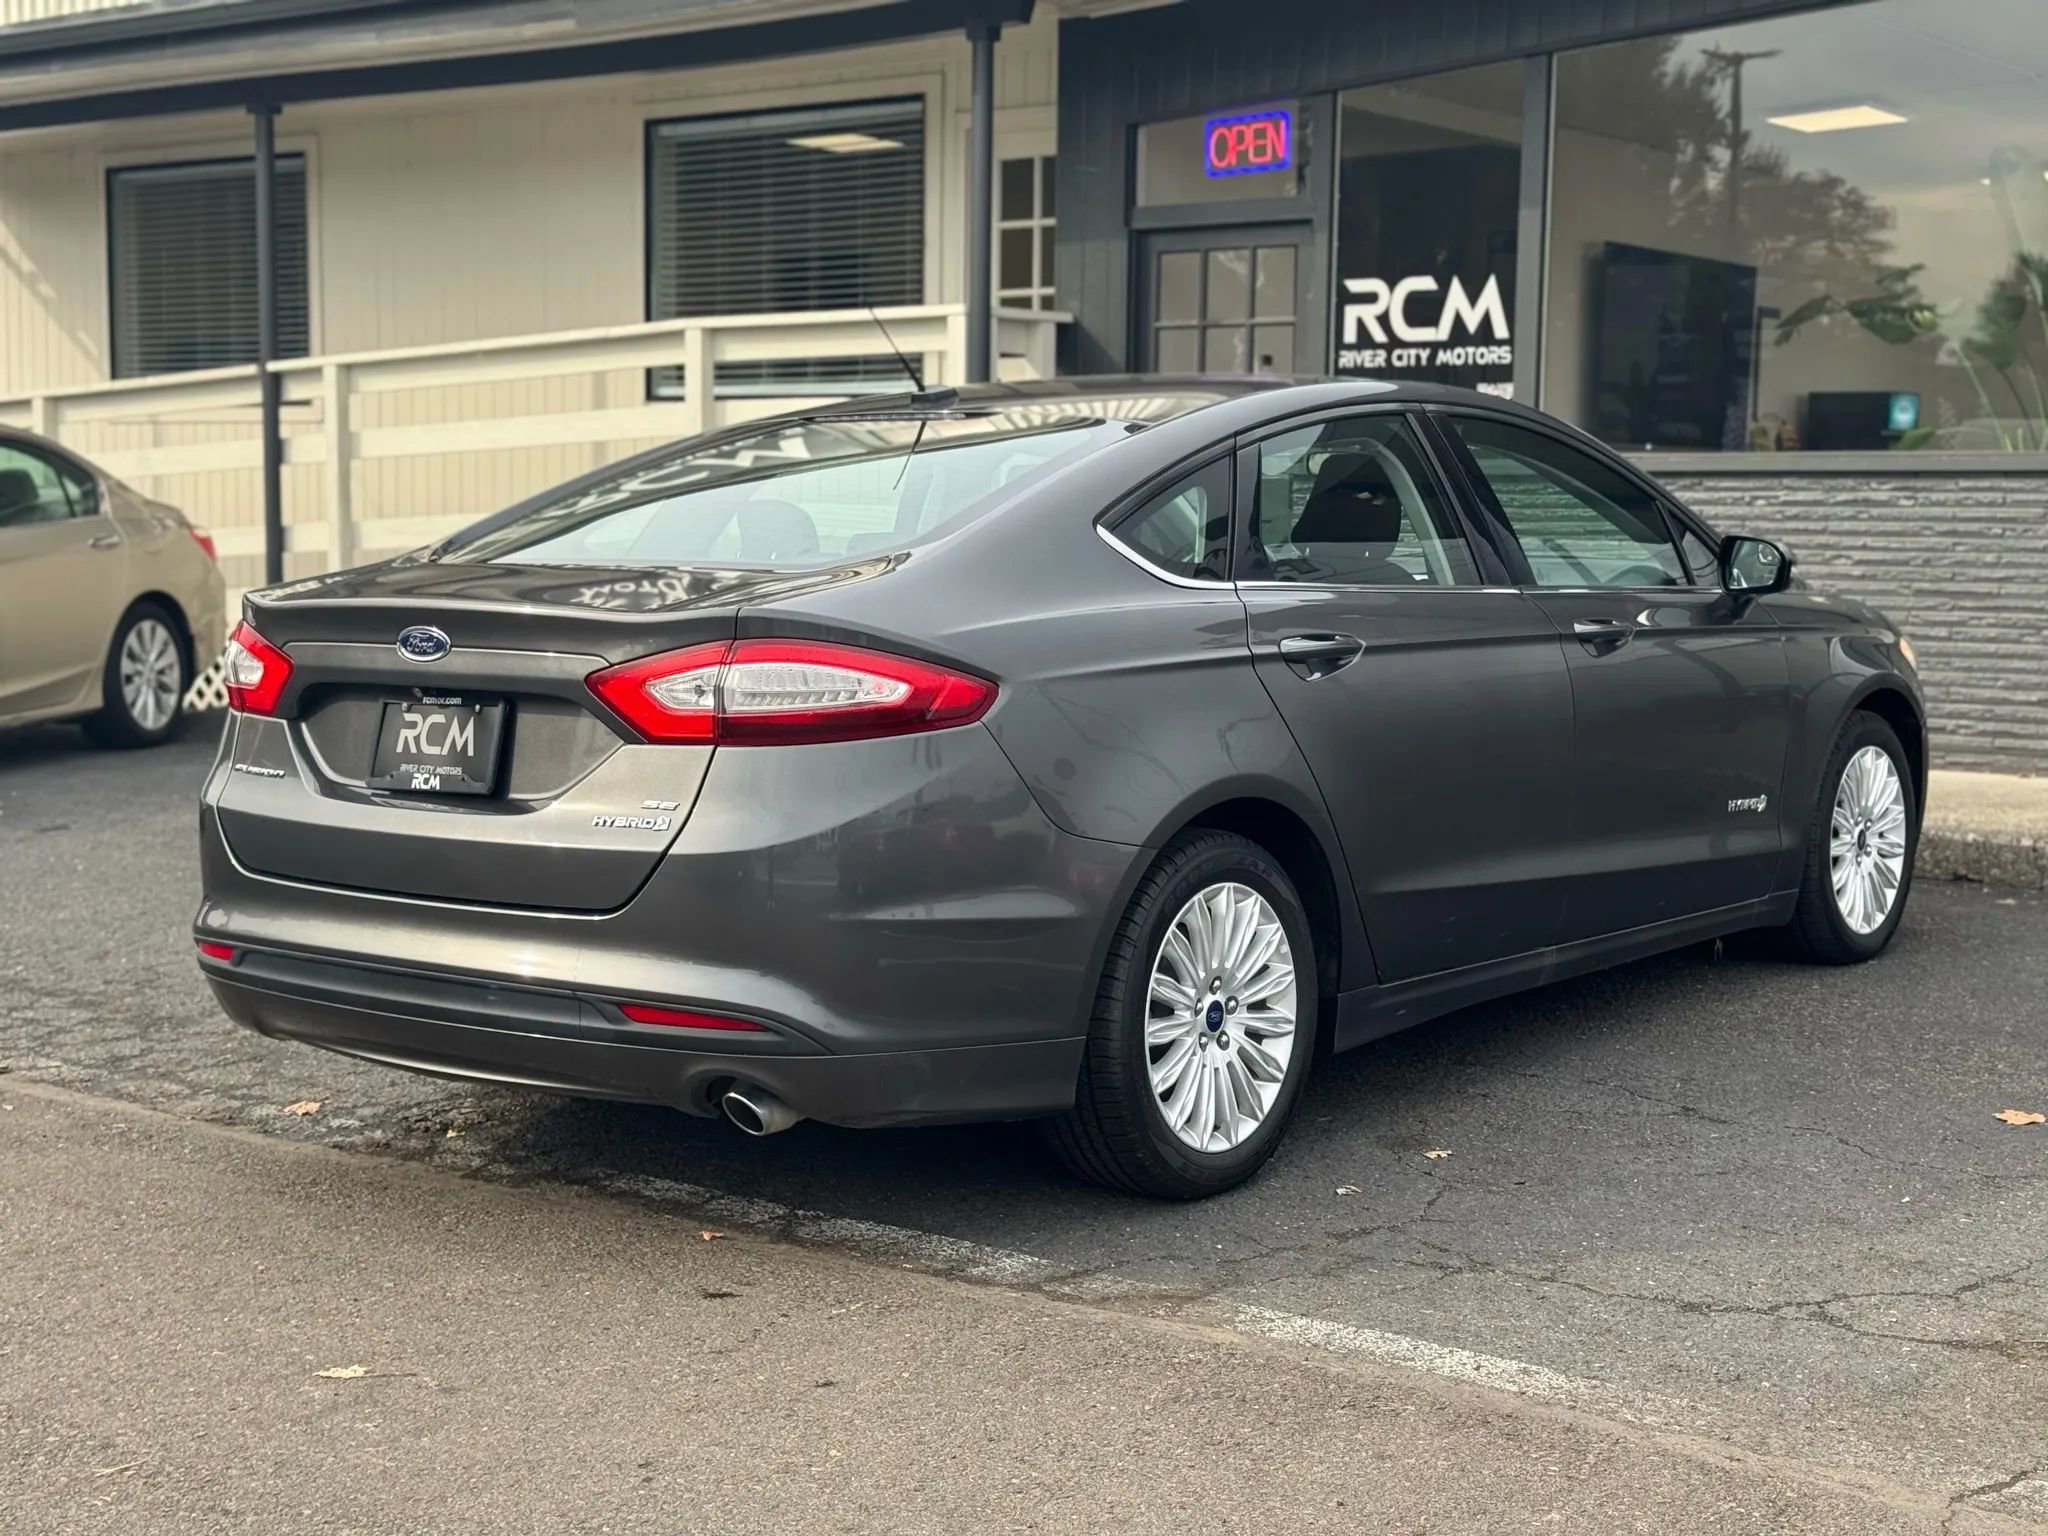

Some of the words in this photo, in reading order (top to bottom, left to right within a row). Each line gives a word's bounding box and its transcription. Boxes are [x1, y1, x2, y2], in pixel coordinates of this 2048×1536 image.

[1209, 119, 1286, 169] OPEN
[1343, 273, 1510, 344] RCM
[1338, 350, 1387, 369] RIVER
[1391, 348, 1431, 367] CITY
[1435, 345, 1513, 366] MOTORS
[406, 632, 438, 653] Ford
[396, 712, 474, 756] RCM
[411, 773, 440, 790] RCM
[640, 800, 680, 811] SE
[591, 815, 657, 830] HYBRID
